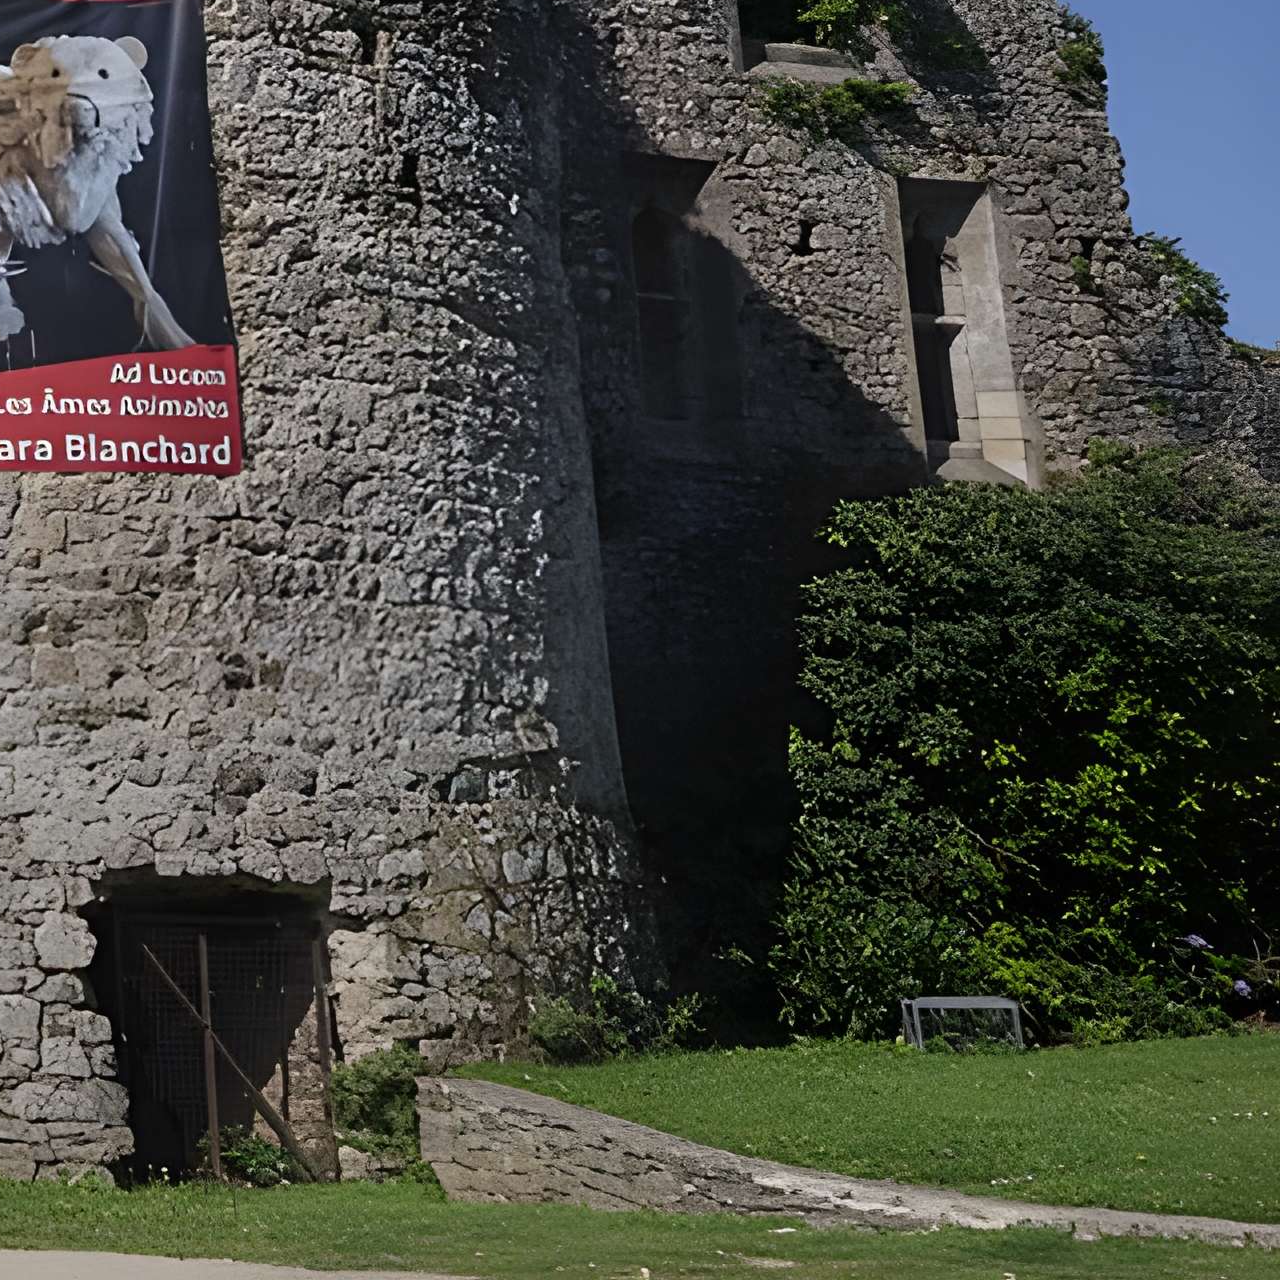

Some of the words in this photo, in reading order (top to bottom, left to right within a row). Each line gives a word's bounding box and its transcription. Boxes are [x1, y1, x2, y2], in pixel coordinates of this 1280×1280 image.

[110, 362, 142, 383] Ad
[119, 394, 229, 419] Animales
[64, 432, 232, 465] Blanchard
